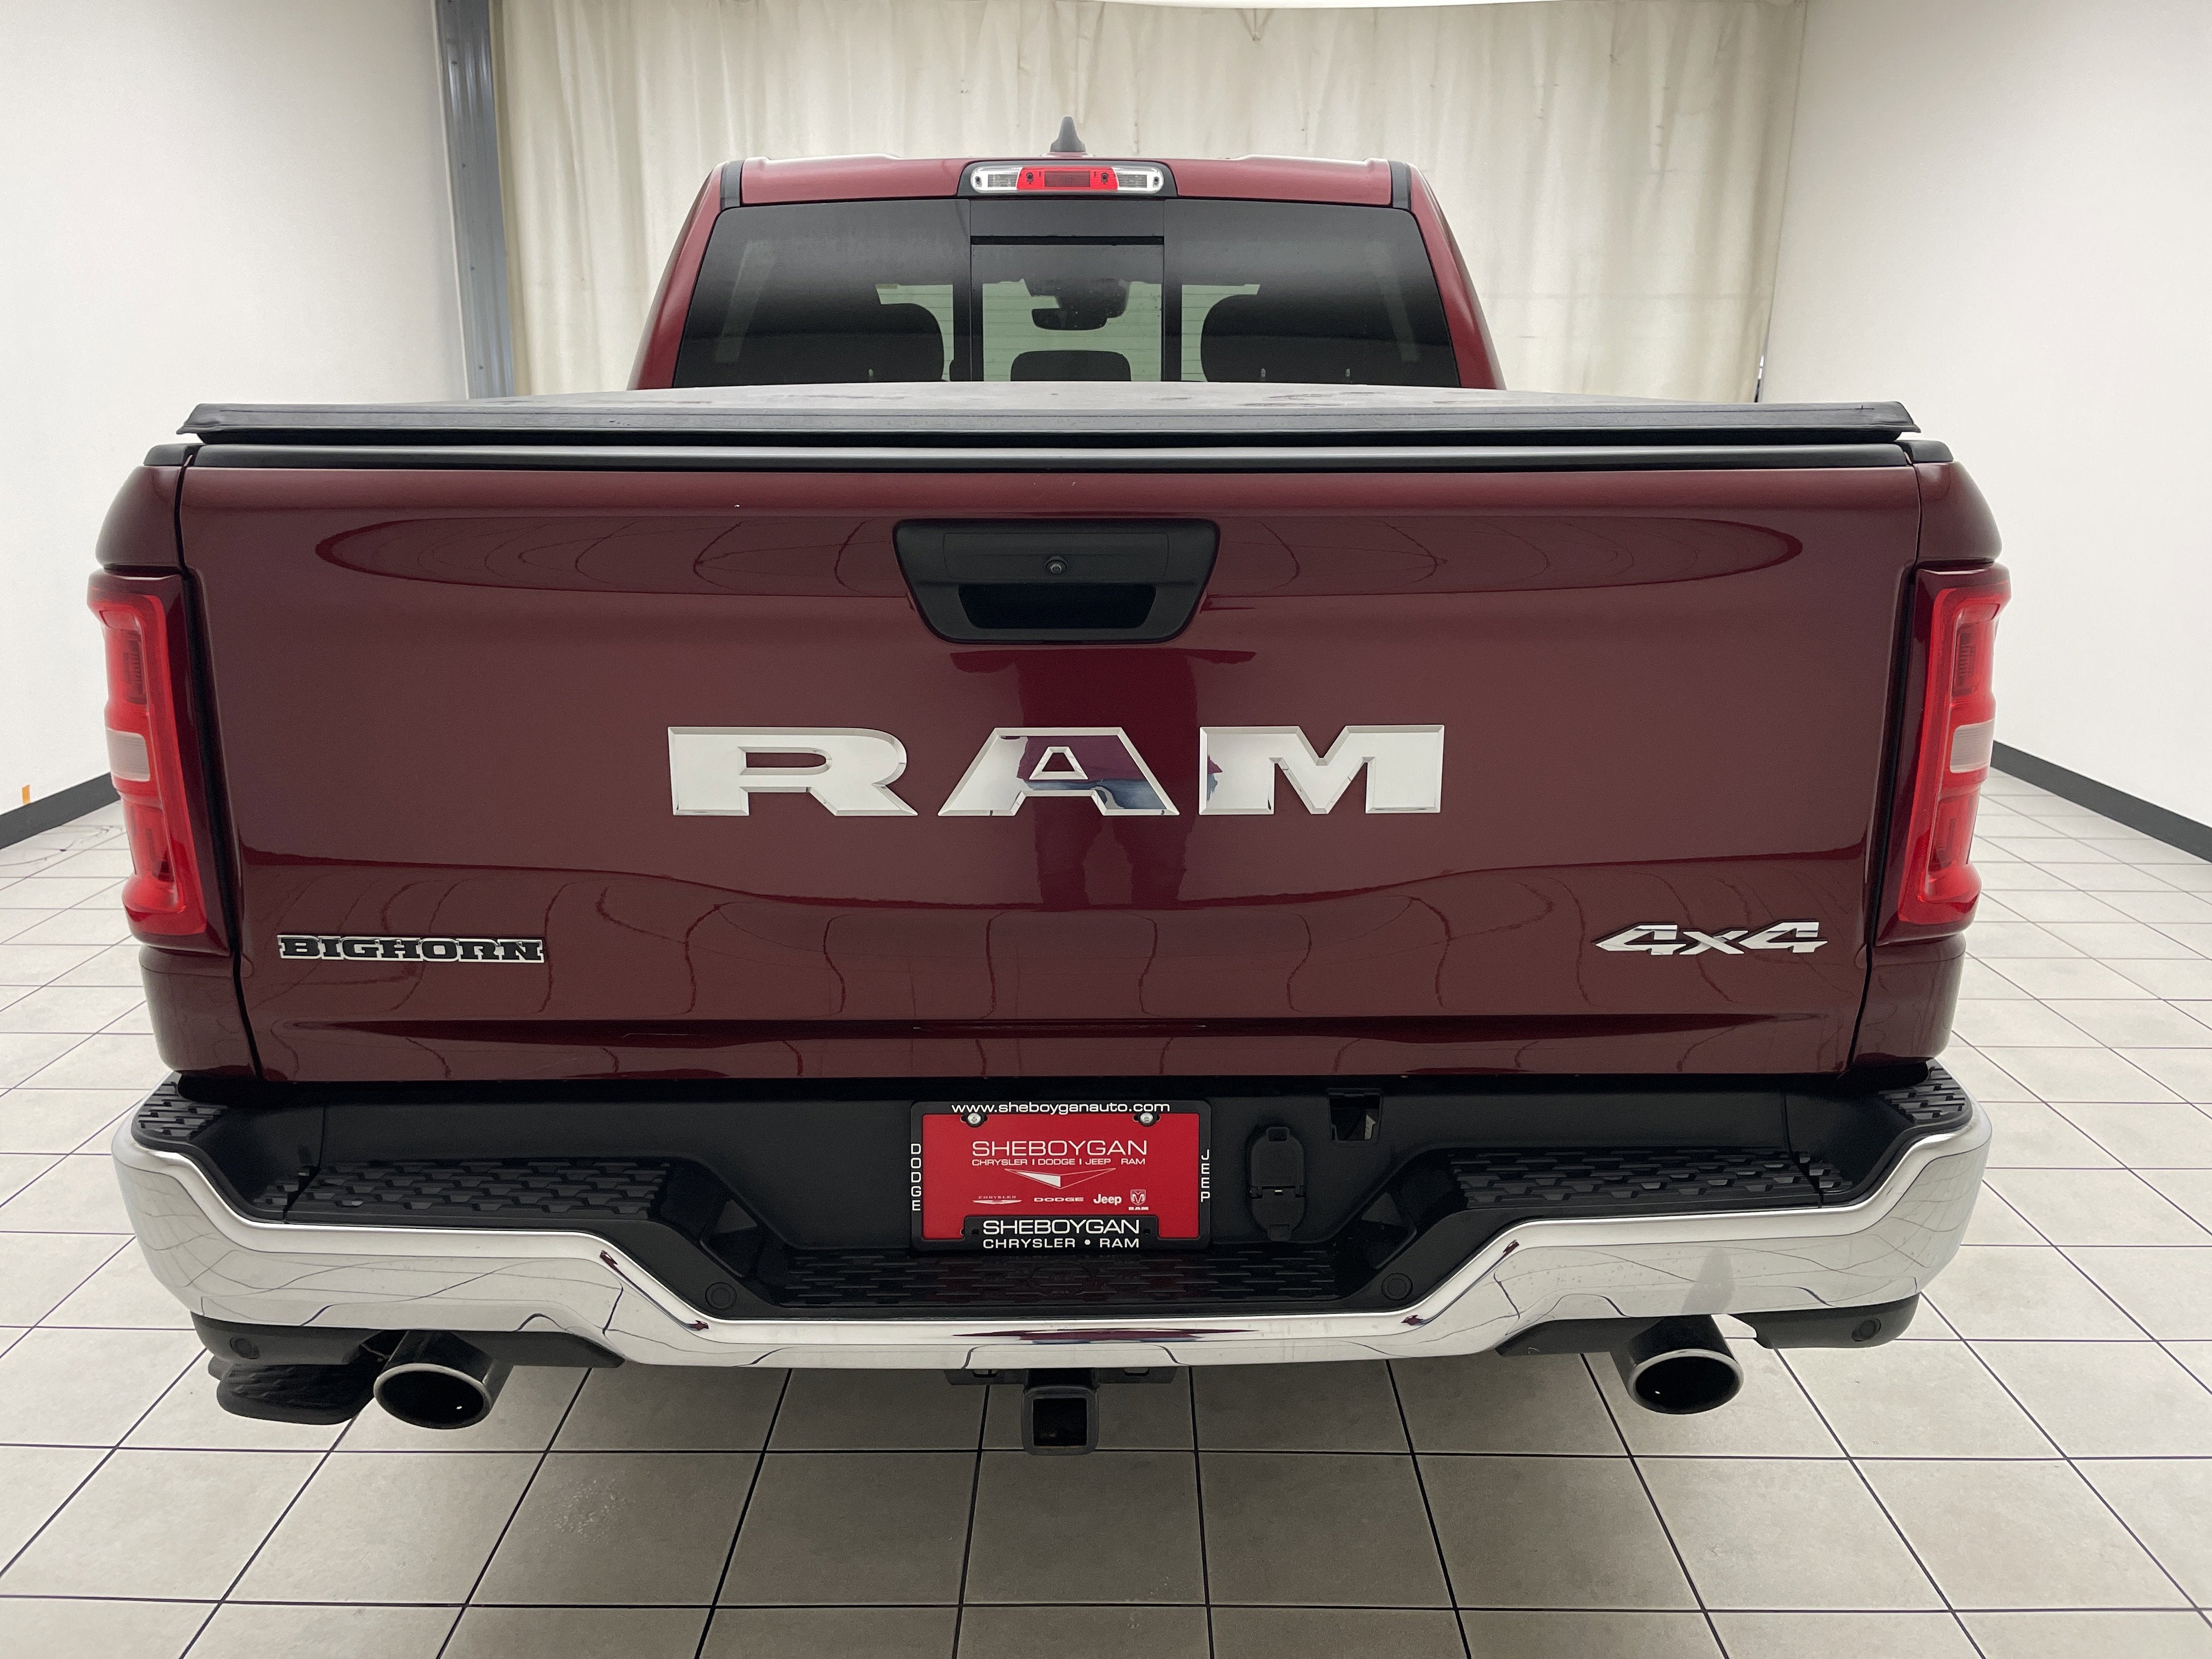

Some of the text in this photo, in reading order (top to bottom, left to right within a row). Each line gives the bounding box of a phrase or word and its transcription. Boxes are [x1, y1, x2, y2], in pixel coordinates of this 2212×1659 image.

[667, 725, 1446, 817] RAM
[1595, 921, 1828, 956] 4x4
[276, 934, 545, 963] BIGHORN
[951, 1102, 1170, 1115] www.sheboyganauto.com
[972, 1139, 1148, 1157] SHEBOYGAN
[972, 1158, 1028, 1166] CHRYSLER
[1037, 1158, 1076, 1166] DODGE
[1085, 1158, 1111, 1166] JEEP
[910, 1143, 922, 1211] DODGE
[1200, 1149, 1211, 1203] JEEP
[1092, 1193, 1122, 1206] Jeep
[983, 1219, 1140, 1235] SHEBOYGAN
[983, 1238, 1139, 1249] CHRYSLER RAM
